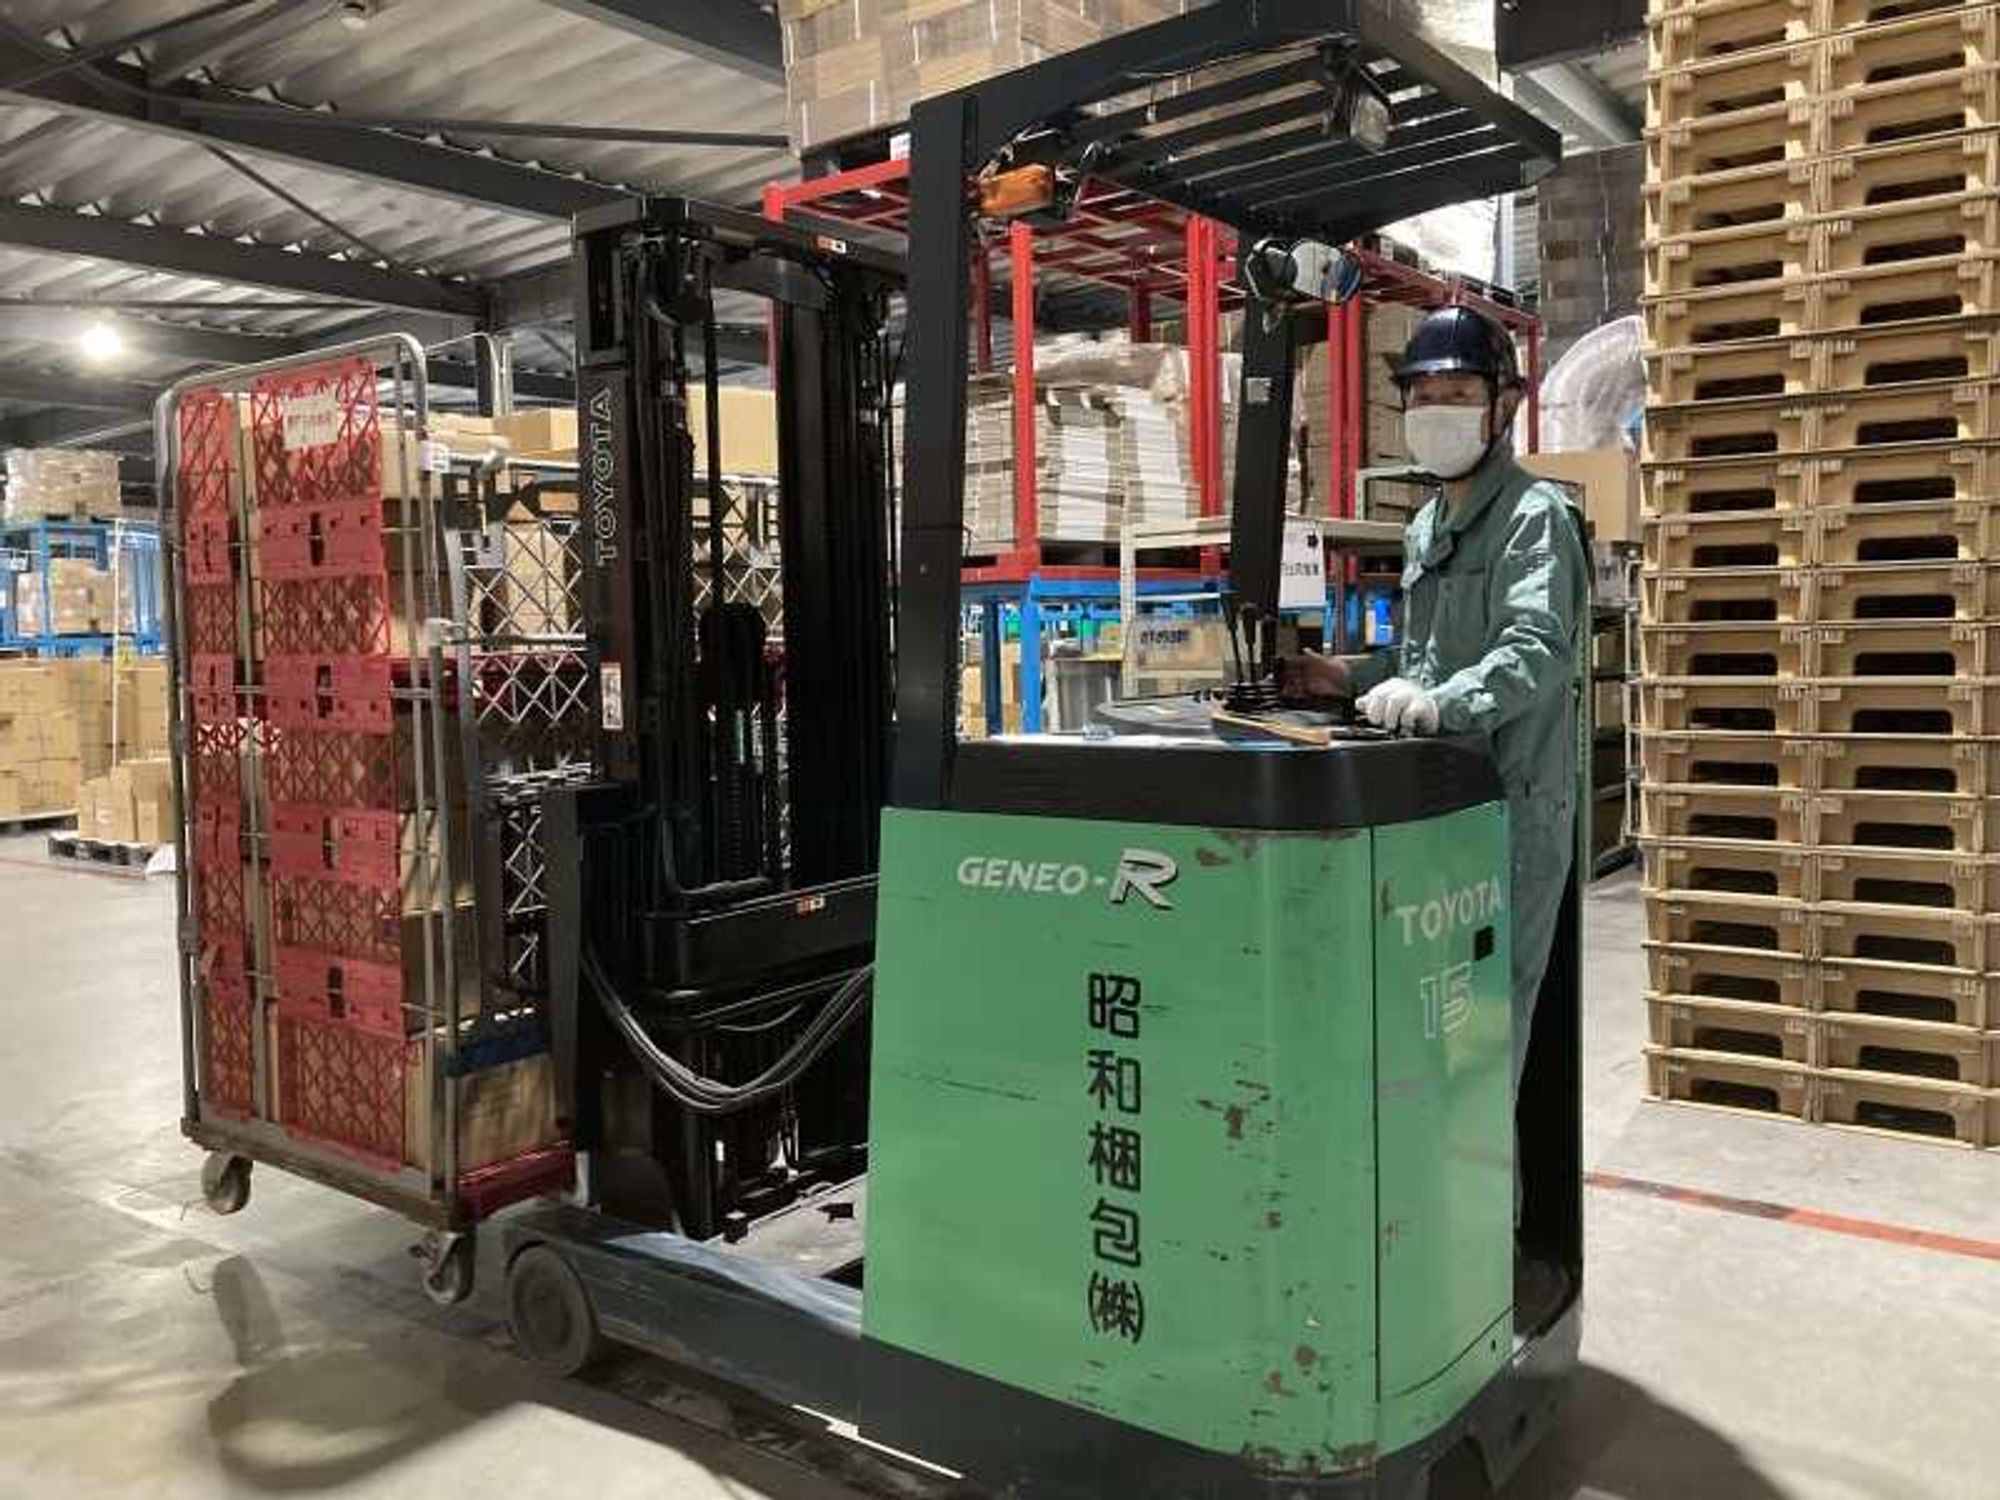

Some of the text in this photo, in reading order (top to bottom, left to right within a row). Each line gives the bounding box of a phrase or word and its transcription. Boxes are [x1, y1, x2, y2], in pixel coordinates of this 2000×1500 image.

[591, 386, 617, 567] TOYOTA
[1394, 875, 1504, 945] TOYOTA
[1419, 959, 1474, 1039] 15
